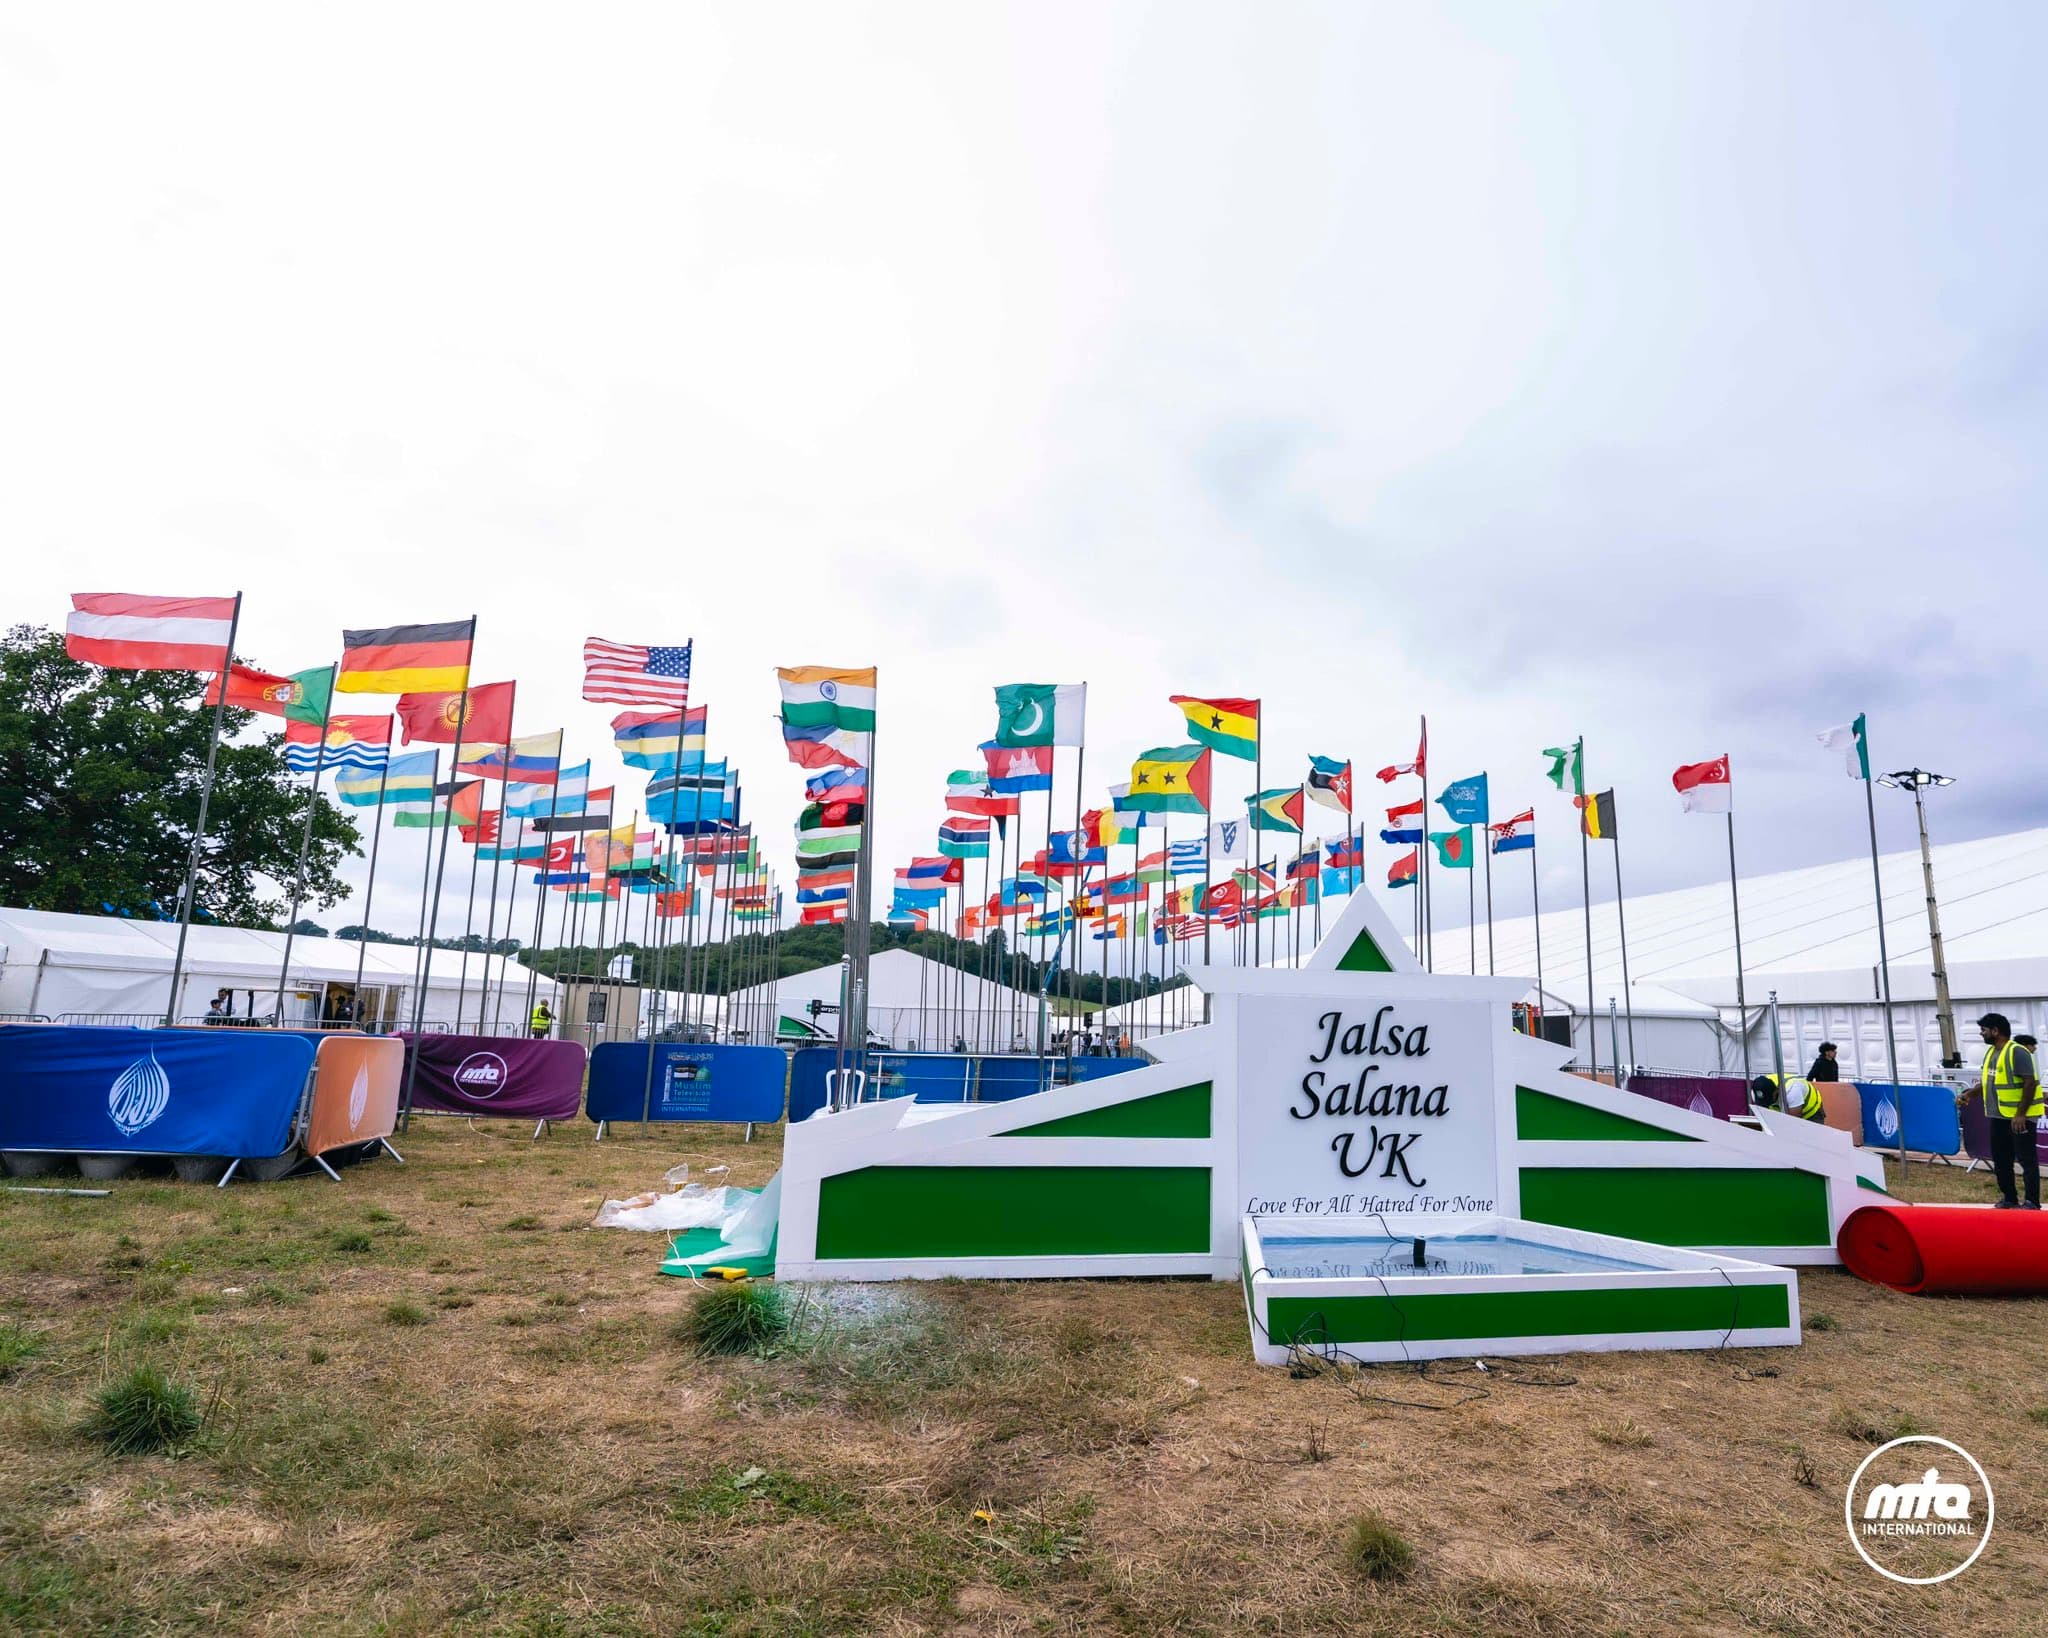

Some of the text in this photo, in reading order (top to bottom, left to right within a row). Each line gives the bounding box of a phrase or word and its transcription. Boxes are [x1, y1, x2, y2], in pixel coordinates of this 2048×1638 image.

[1310, 1006, 1430, 1063] Jalsa
[461, 1063, 499, 1080] mta
[675, 1081, 712, 1090] Muslim
[1290, 1065, 1450, 1120] Salana
[1331, 1125, 1427, 1188] UK
[1246, 1194, 1494, 1216] Love For All Hatred For None
